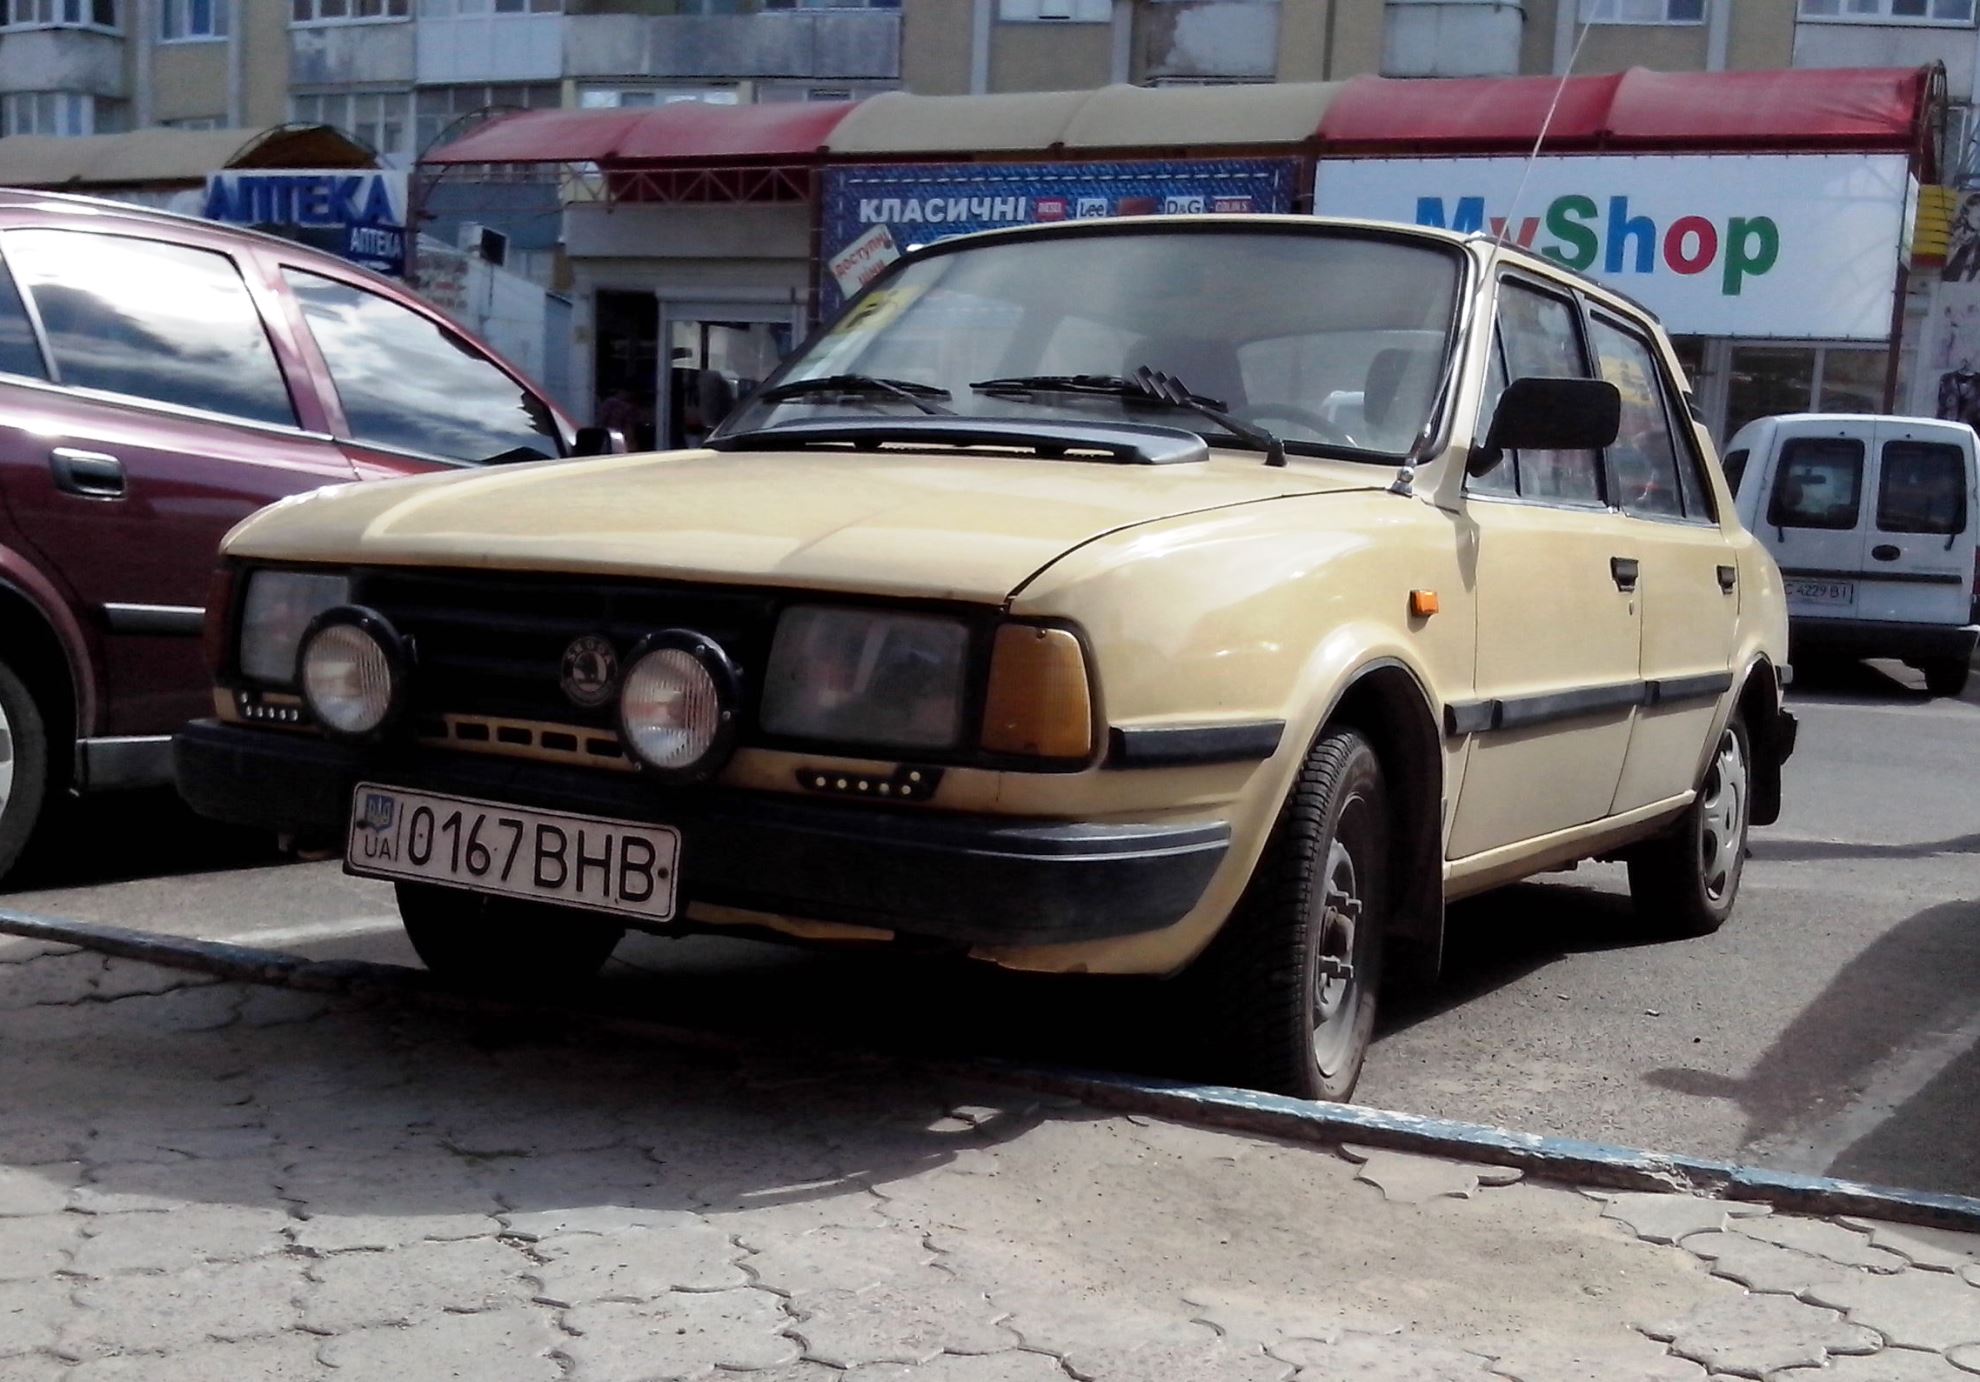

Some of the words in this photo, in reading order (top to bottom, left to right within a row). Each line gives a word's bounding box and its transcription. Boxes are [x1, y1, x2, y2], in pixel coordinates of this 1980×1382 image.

[203, 174, 396, 223] АПТЕКА
[859, 196, 1027, 223] КЛАСИЧНІ
[1080, 200, 1105, 218] Lee
[1167, 200, 1201, 216] D&G
[351, 227, 400, 255] АПТЕКА
[364, 834, 392, 861] UA
